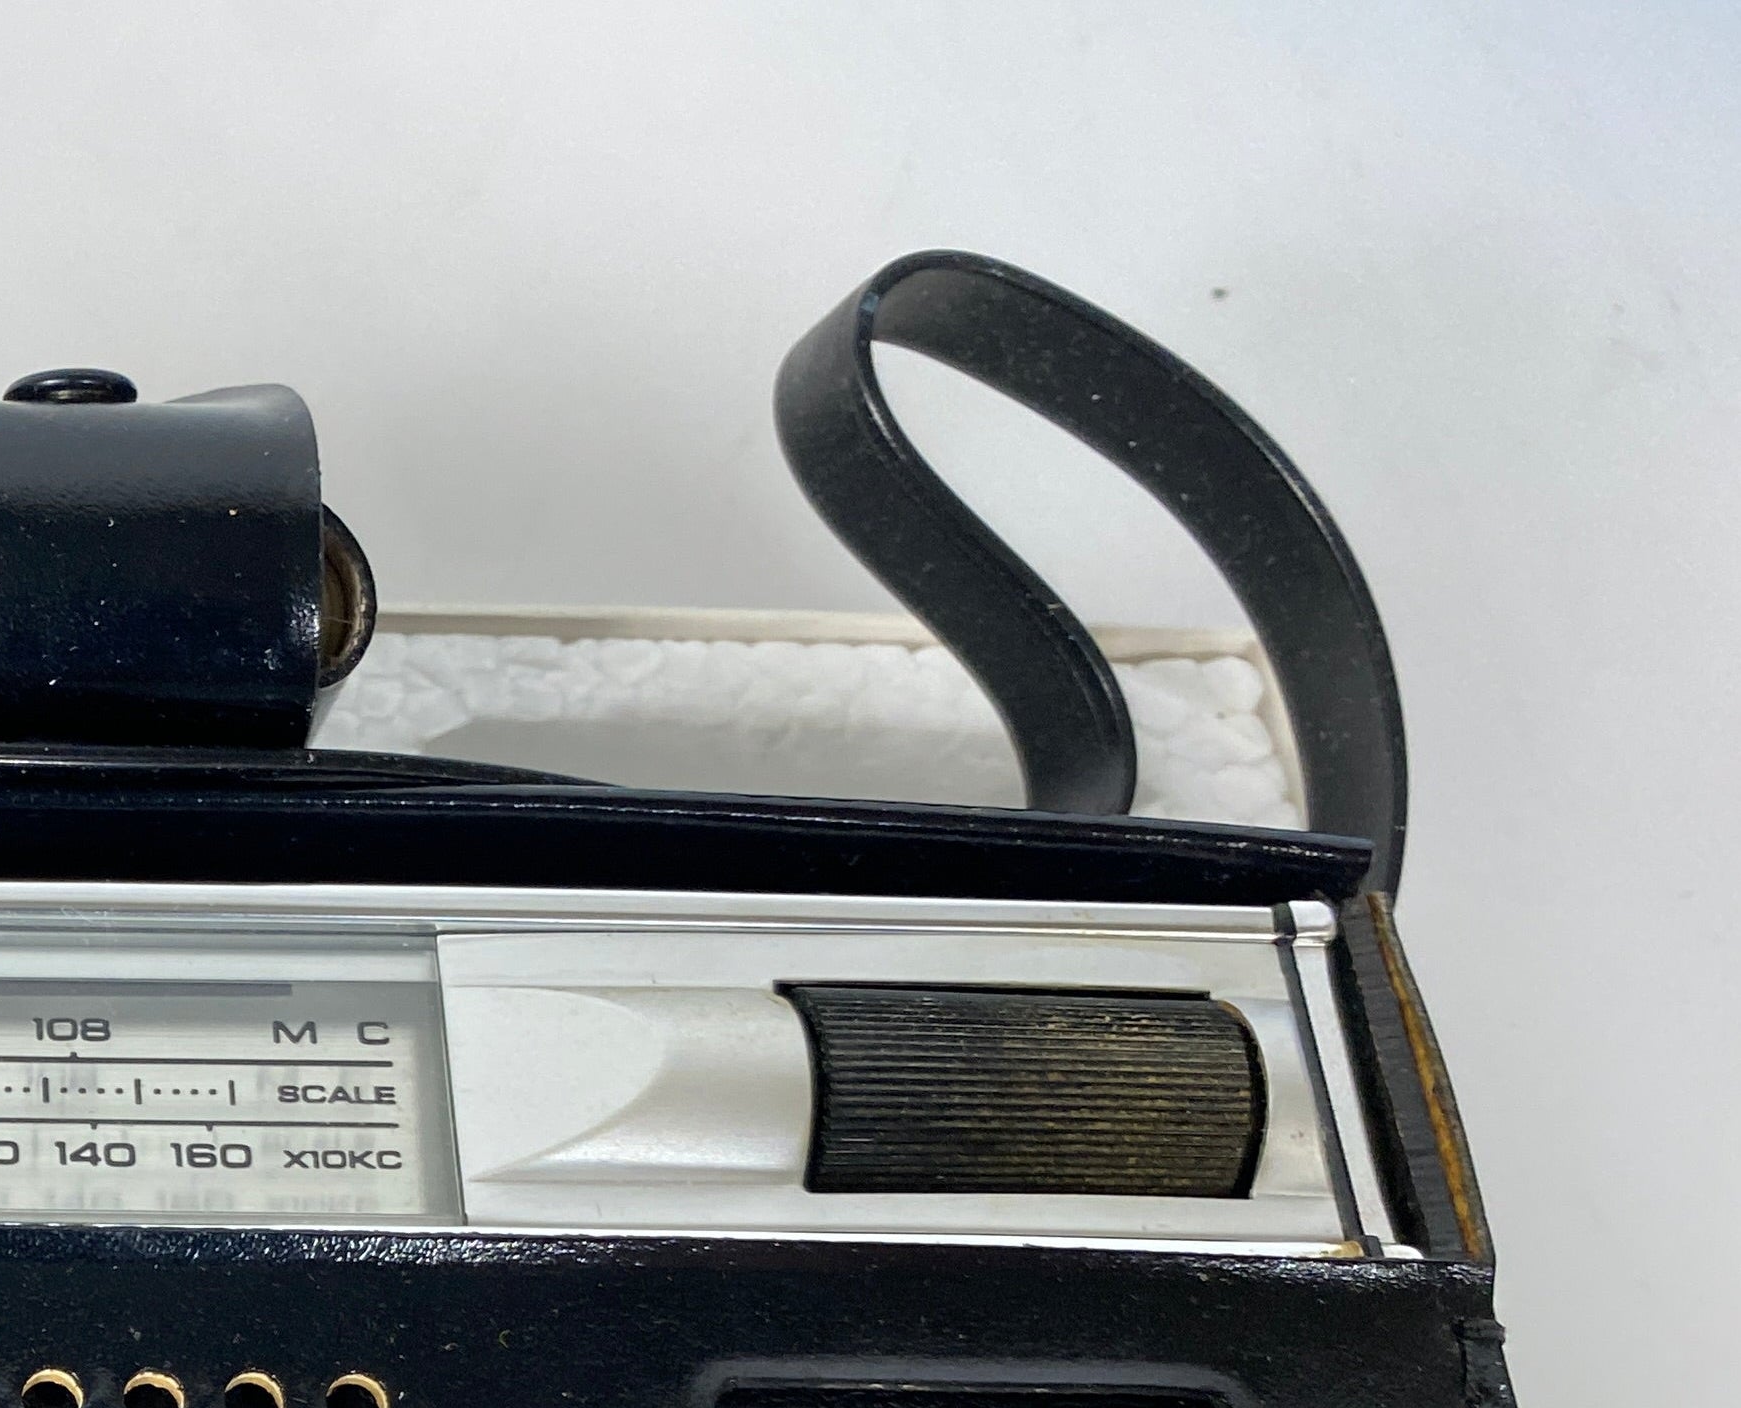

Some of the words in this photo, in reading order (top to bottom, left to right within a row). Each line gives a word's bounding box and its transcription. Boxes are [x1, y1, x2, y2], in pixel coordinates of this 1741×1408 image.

[33, 1018, 111, 1041] 108
[277, 1085, 396, 1105] SCALE
[55, 1141, 136, 1167] 140
[170, 1142, 252, 1168] 160
[283, 1149, 402, 1169] X10KC
